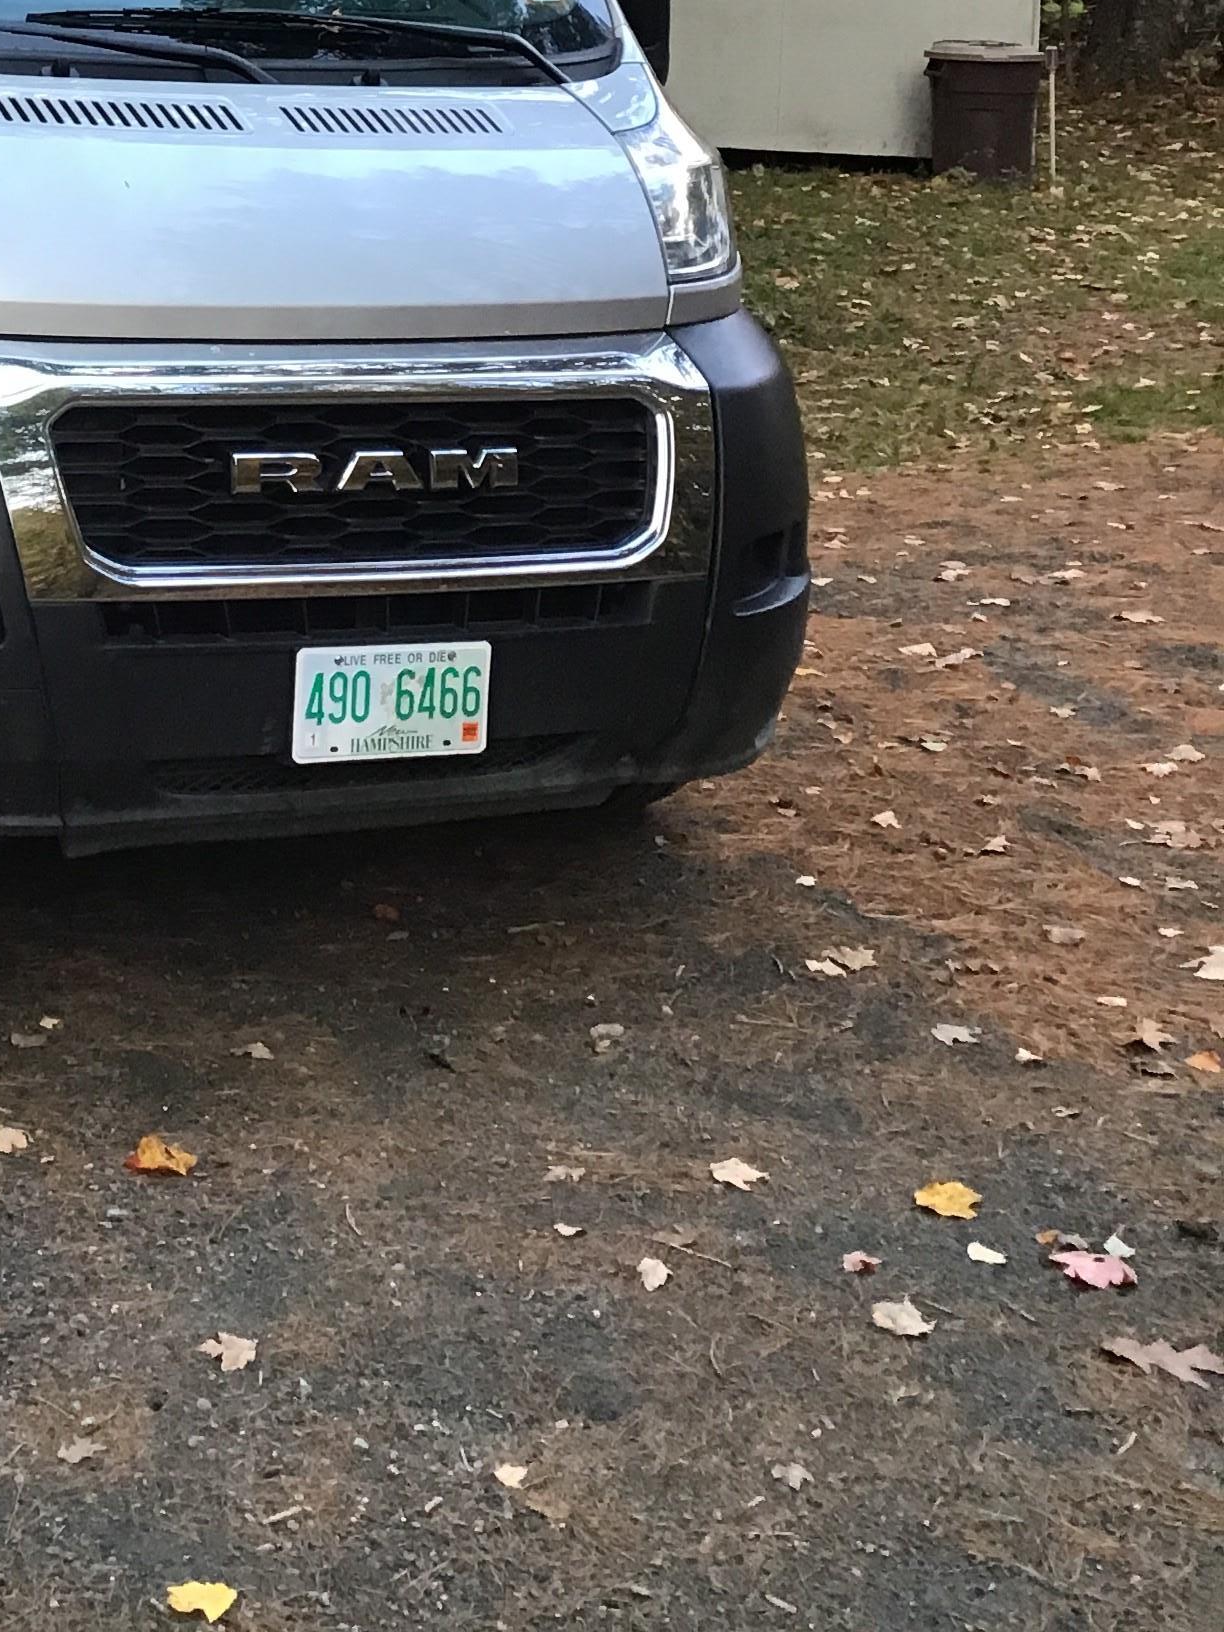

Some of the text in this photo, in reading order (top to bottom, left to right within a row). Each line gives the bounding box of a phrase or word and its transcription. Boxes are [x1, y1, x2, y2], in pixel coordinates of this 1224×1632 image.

[231, 448, 518, 494] RAM
[344, 650, 447, 666] LIVE FREE OR DIE
[304, 666, 482, 726] 490 6466
[350, 734, 433, 753] HAMPSHIRE
